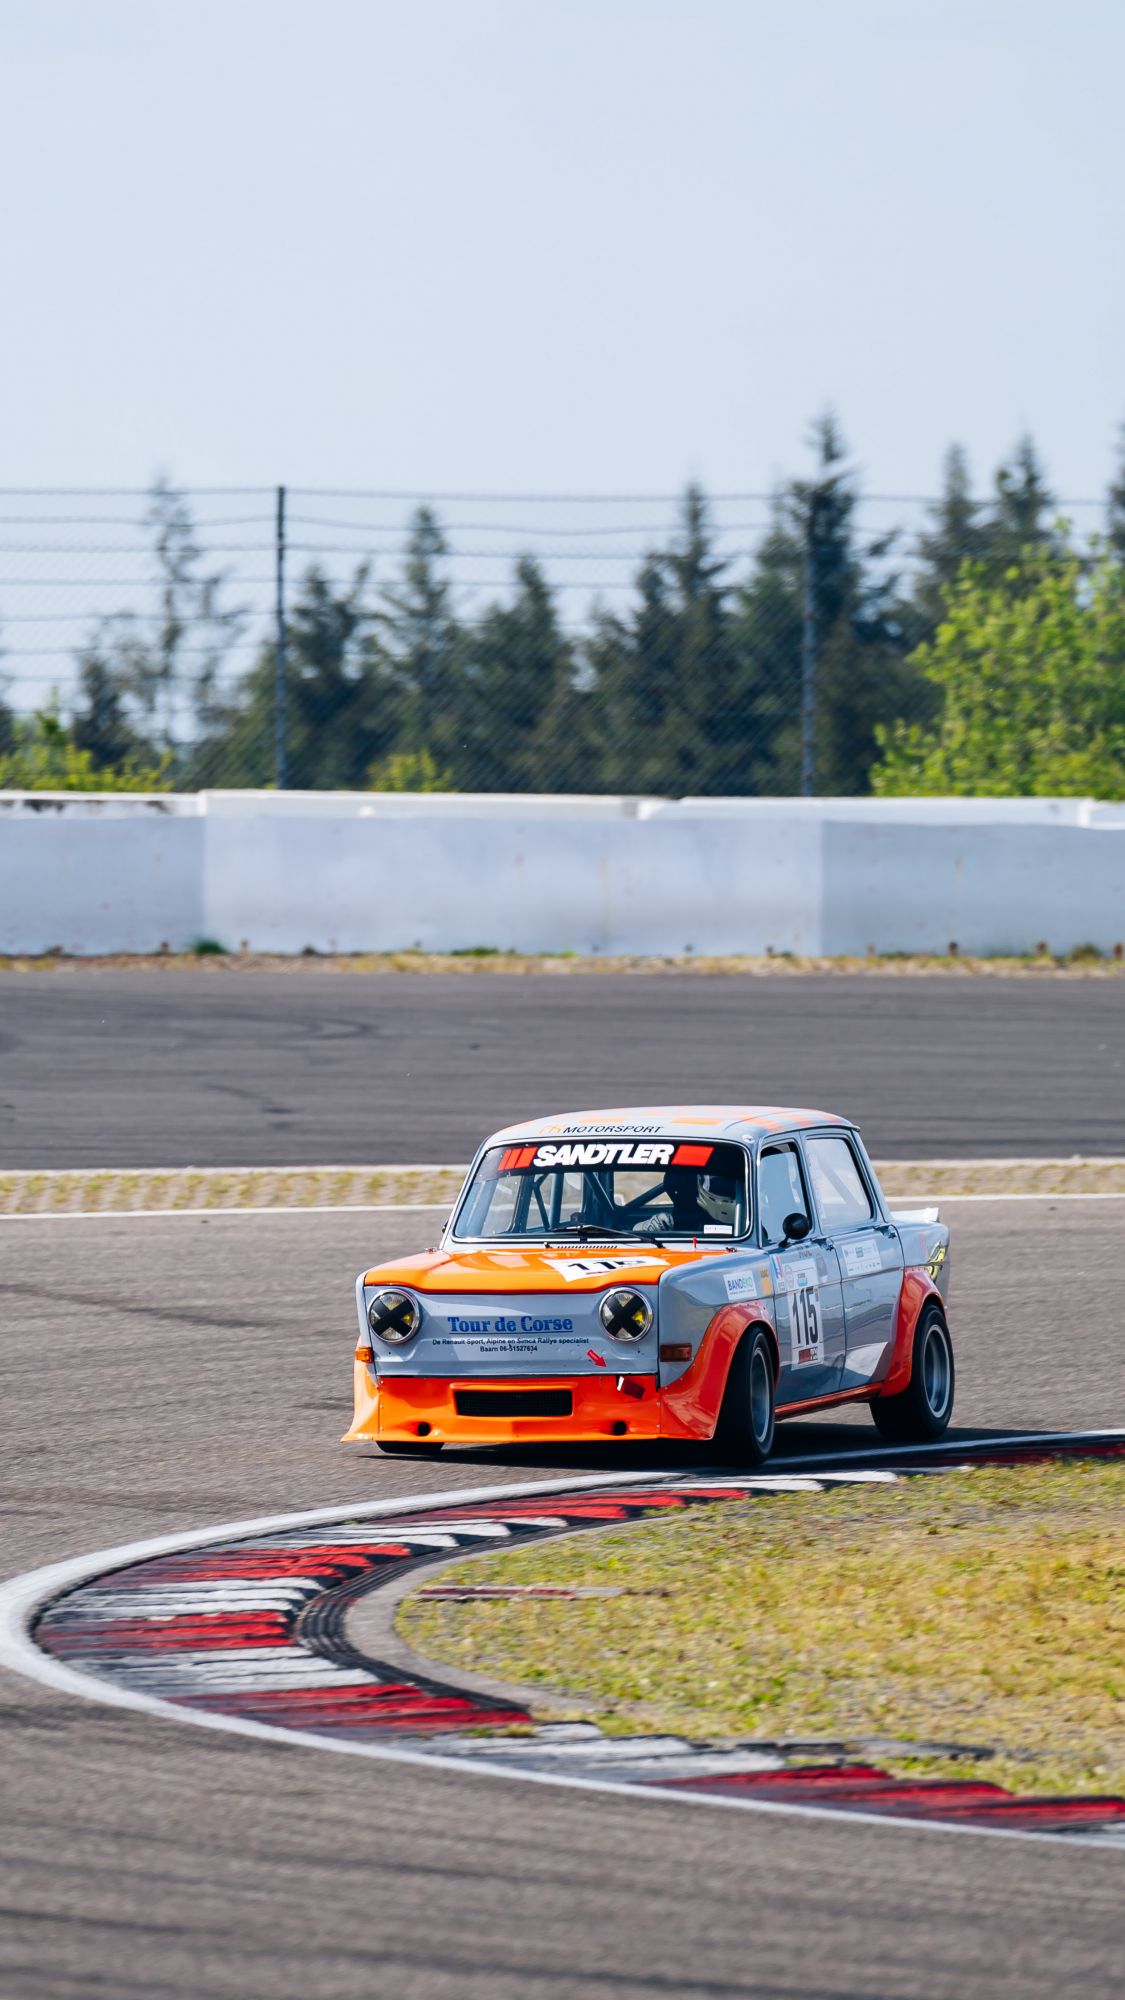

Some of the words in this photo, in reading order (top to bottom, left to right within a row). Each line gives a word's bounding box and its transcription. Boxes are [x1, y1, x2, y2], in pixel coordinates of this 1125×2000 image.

[563, 1126, 664, 1134] MOTORSPORT
[533, 1144, 675, 1168] SANDTLER
[792, 1286, 819, 1345] 115
[447, 1316, 490, 1332] Tour
[494, 1316, 517, 1332] de
[521, 1316, 573, 1332] Corse
[487, 1338, 506, 1346] Alpine
[537, 1337, 557, 1345] Rallye
[558, 1337, 590, 1345] specialist
